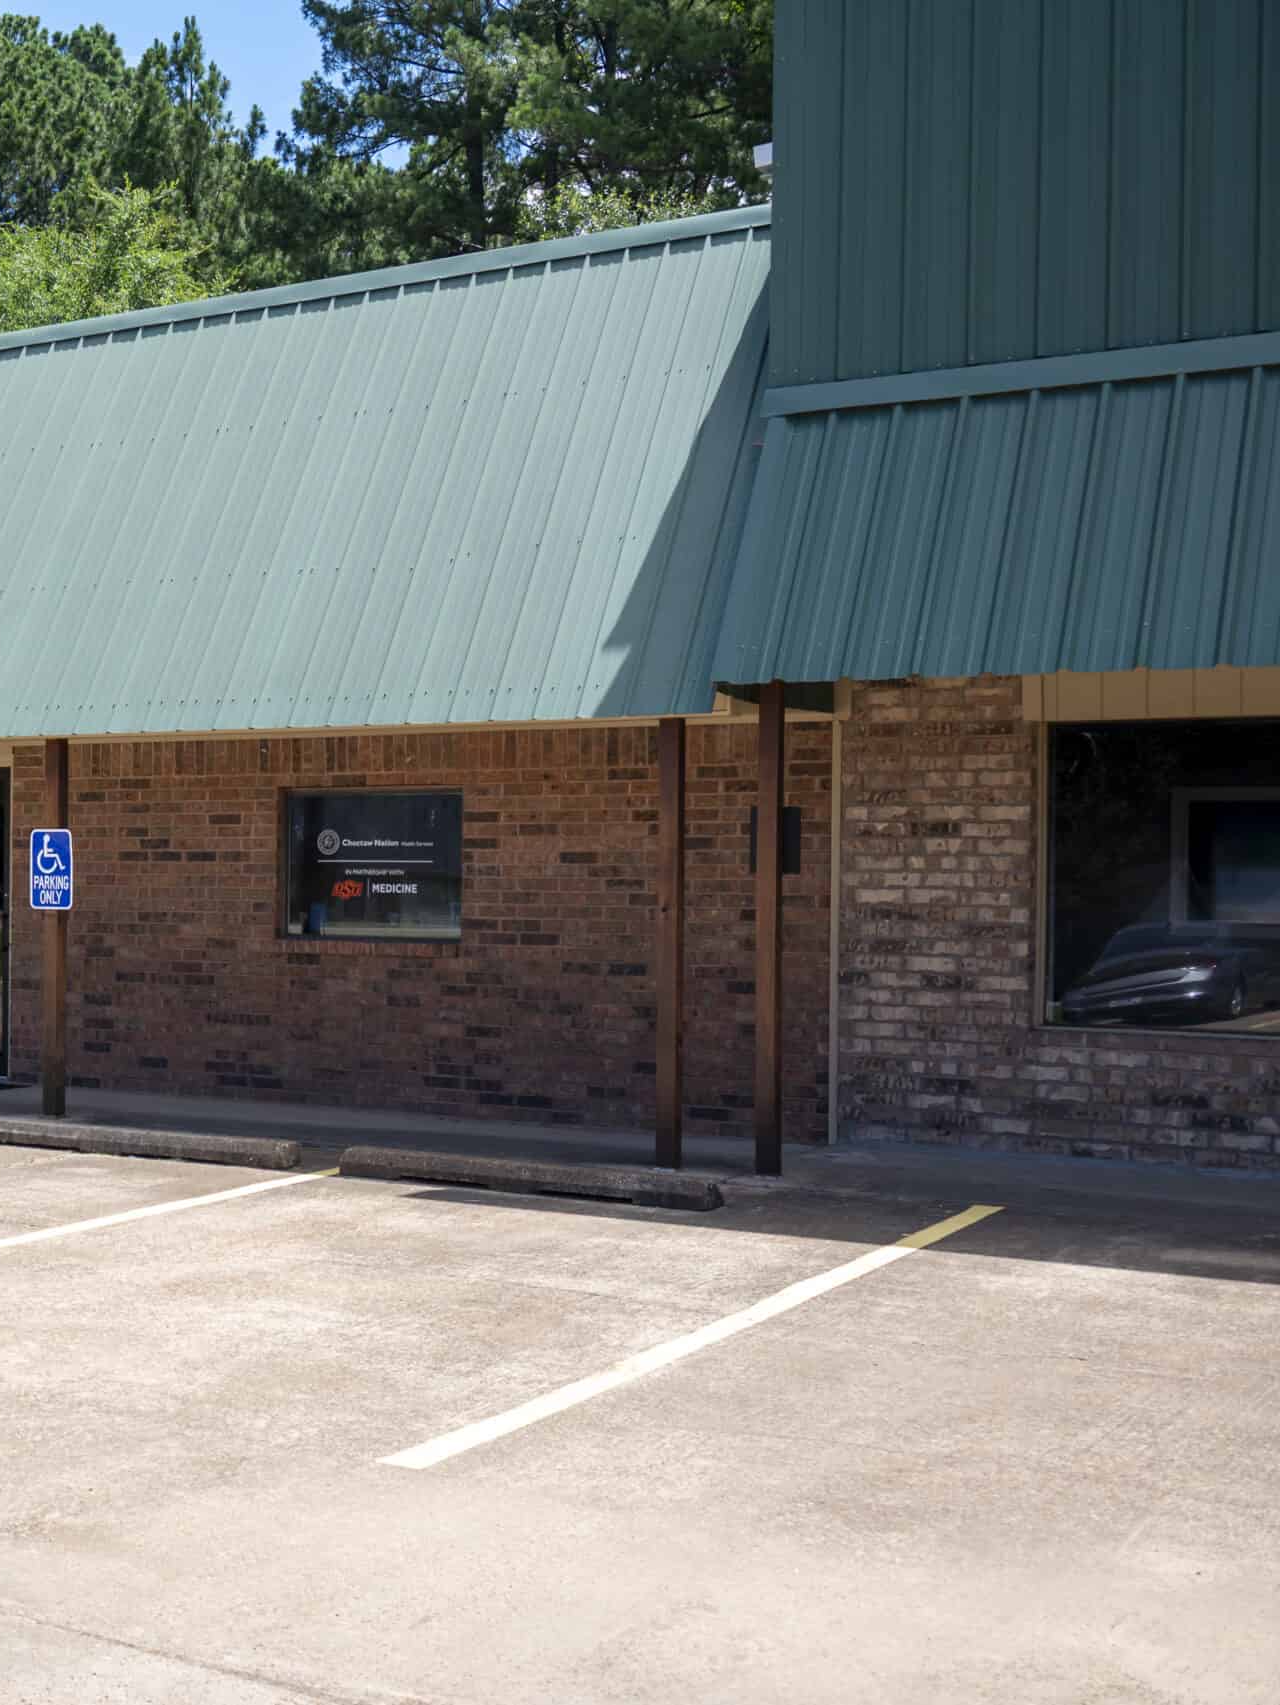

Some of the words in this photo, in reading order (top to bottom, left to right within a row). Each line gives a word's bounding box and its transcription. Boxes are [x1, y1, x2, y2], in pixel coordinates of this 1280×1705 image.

[34, 875, 69, 890] PARKING
[372, 883, 418, 894] MEDICINE
[40, 891, 62, 904] ONLY
